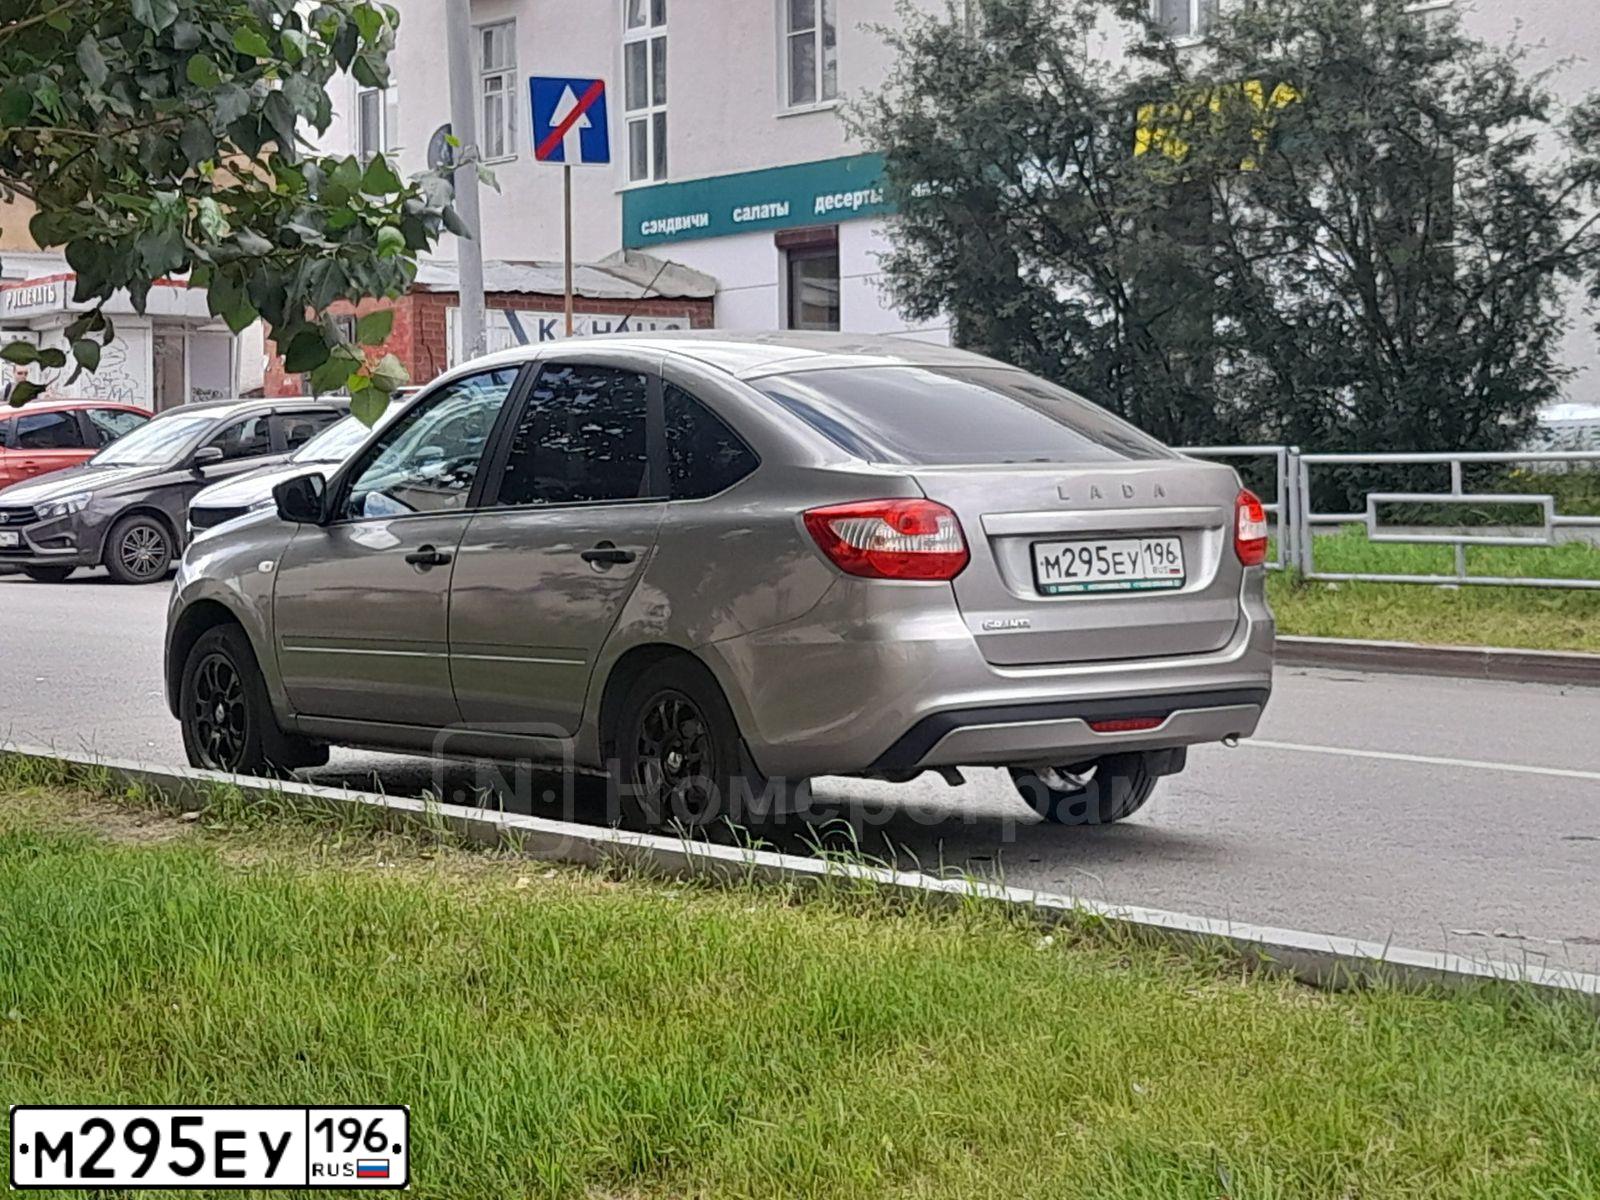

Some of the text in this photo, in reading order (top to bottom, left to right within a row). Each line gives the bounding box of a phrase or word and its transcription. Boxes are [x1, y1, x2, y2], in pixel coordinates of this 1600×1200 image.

[641, 212, 709, 236] сэндвичи
[733, 201, 790, 223] салаты
[814, 187, 884, 215] десерты
[1057, 484, 1167, 501] LADA
[1043, 542, 1178, 579] М295ЕУ 196
